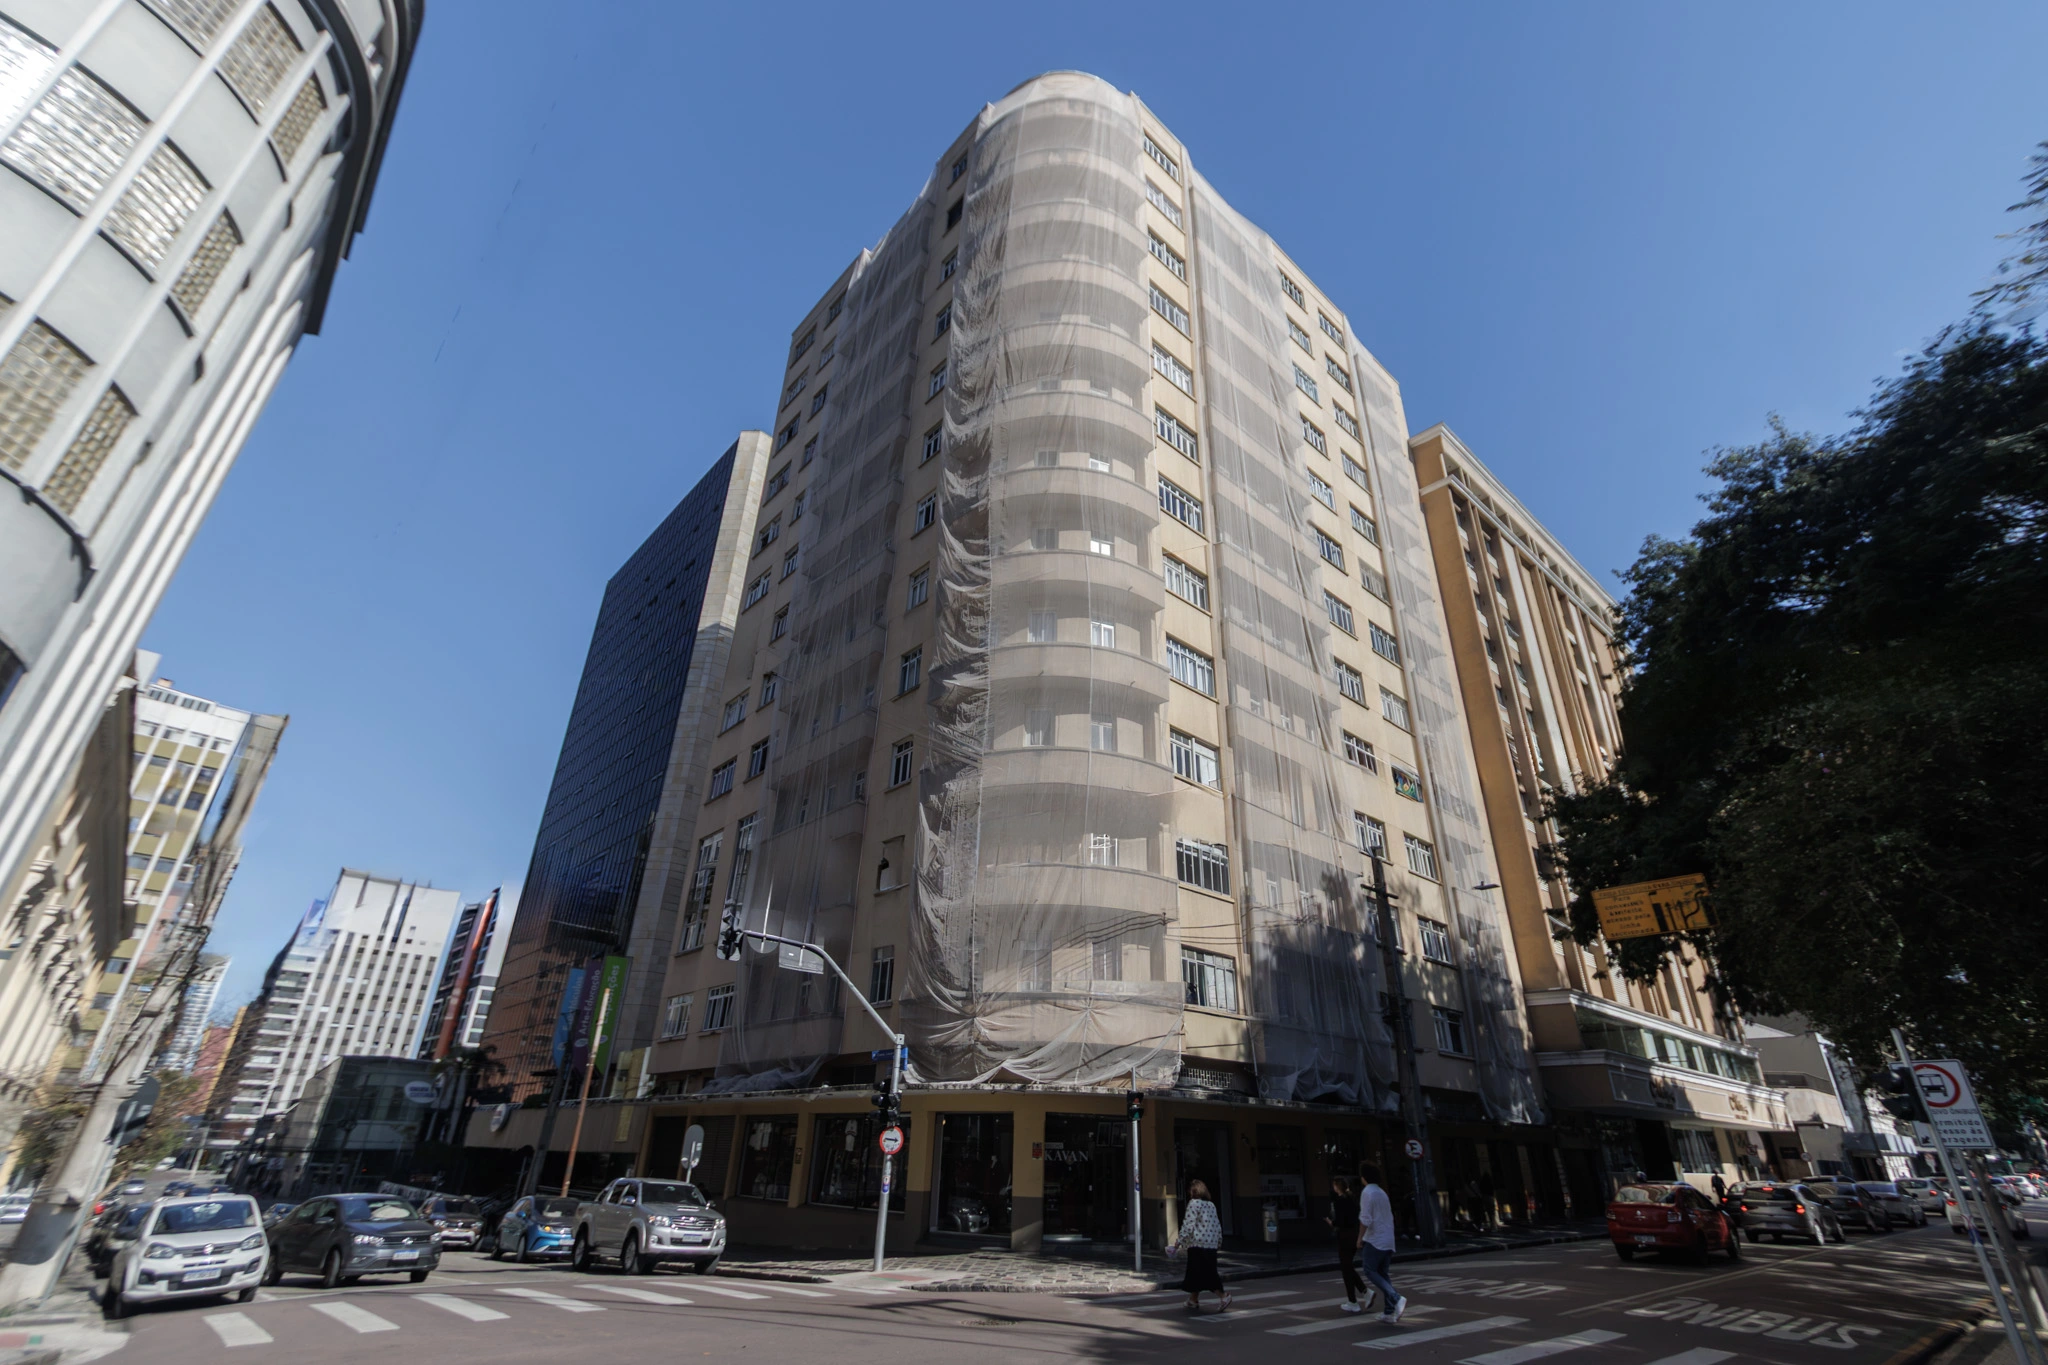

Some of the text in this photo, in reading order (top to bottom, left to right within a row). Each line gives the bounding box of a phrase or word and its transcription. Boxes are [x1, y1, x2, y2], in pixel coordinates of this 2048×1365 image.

[1934, 1118, 1981, 1127] ermitido
[1942, 1136, 1986, 1145] aragens
[1624, 1296, 1883, 1350] ÔNIBUS
